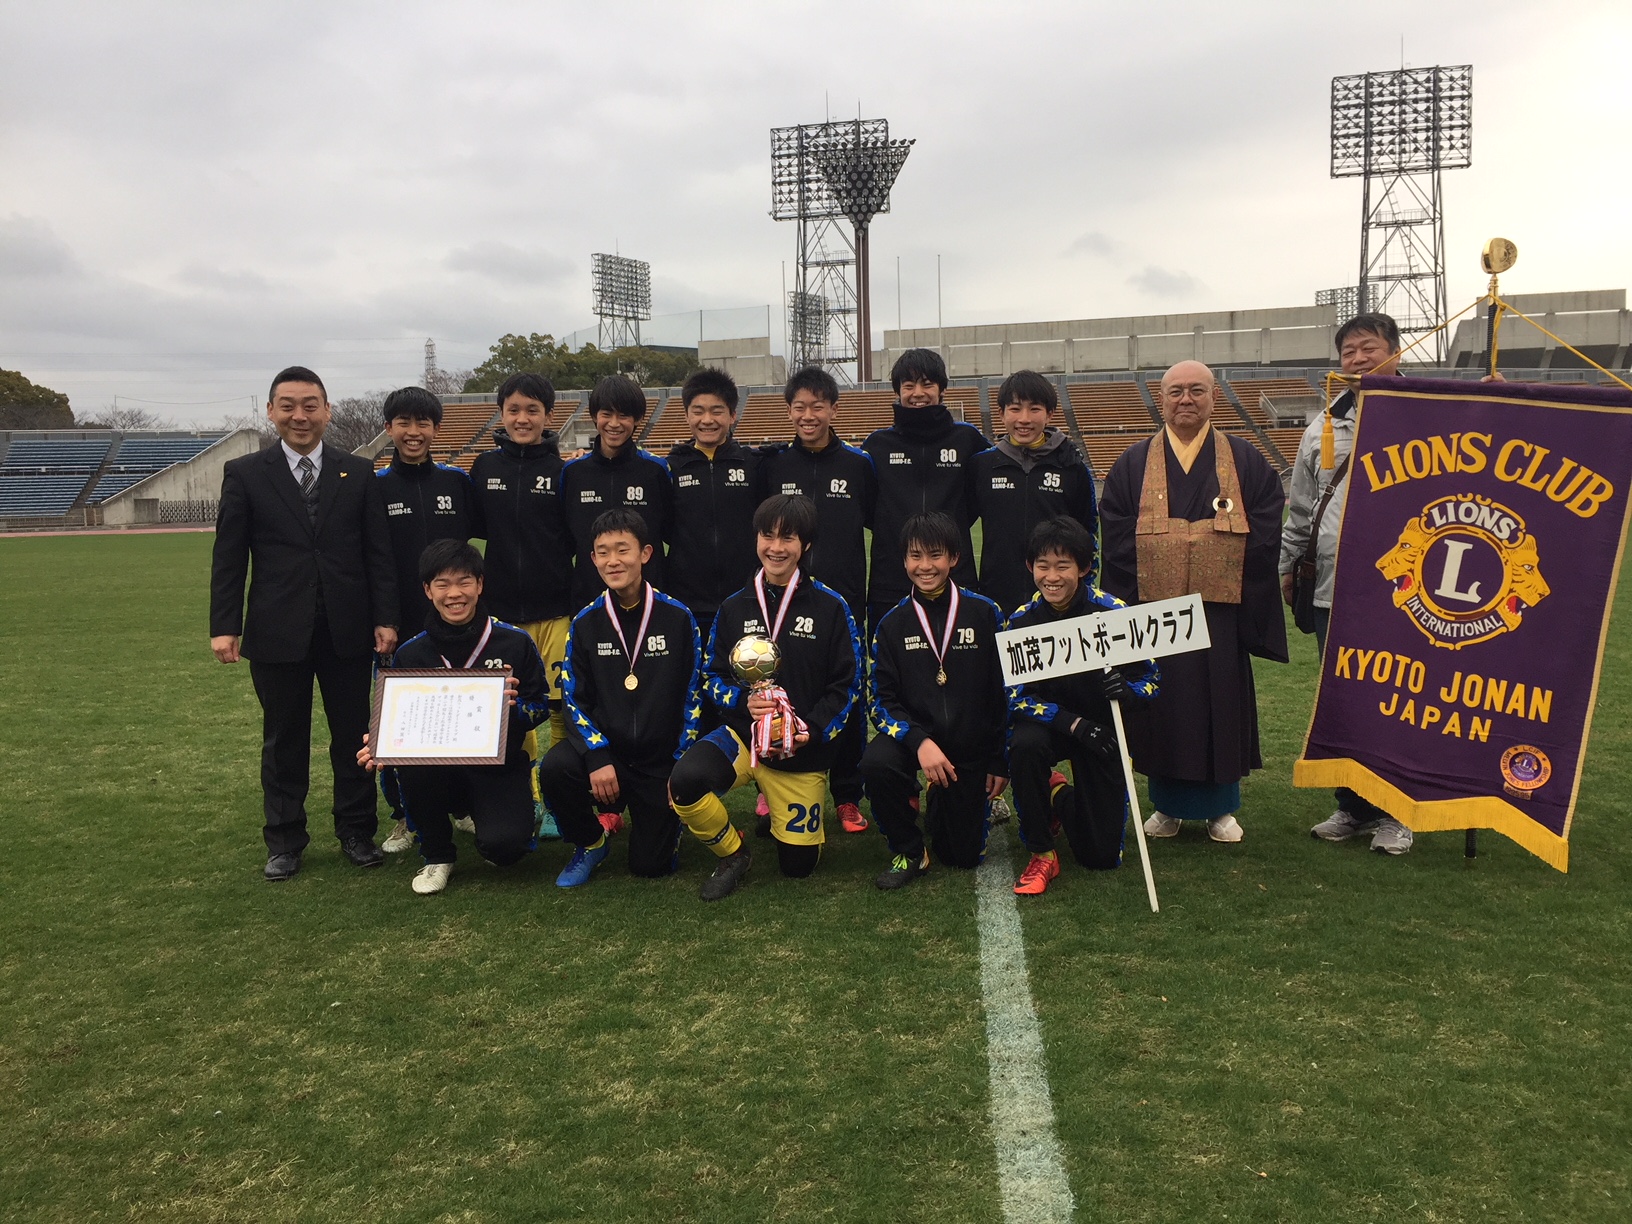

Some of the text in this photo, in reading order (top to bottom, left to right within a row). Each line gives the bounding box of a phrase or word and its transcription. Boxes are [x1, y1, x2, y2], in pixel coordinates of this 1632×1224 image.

[940, 449, 957, 462] 80
[536, 476, 551, 489] 21
[728, 469, 745, 482] 36
[1044, 472, 1060, 487] 35
[1360, 432, 1614, 518] LIONS CLUB
[627, 486, 643, 500] 89
[830, 479, 847, 493] 62
[437, 496, 452, 509] 33
[1430, 502, 1517, 540] LIONS
[1434, 538, 1482, 604] L
[794, 616, 814, 633] 28
[1406, 596, 1504, 638] INTERNATIONAL
[648, 635, 666, 652] 85
[957, 628, 974, 644] 79
[1006, 604, 1194, 676] 加茂フットボールクラブ
[1335, 646, 1552, 723] KYOTO JONAN
[1379, 693, 1492, 742] JAPAN
[786, 803, 820, 833] 28
